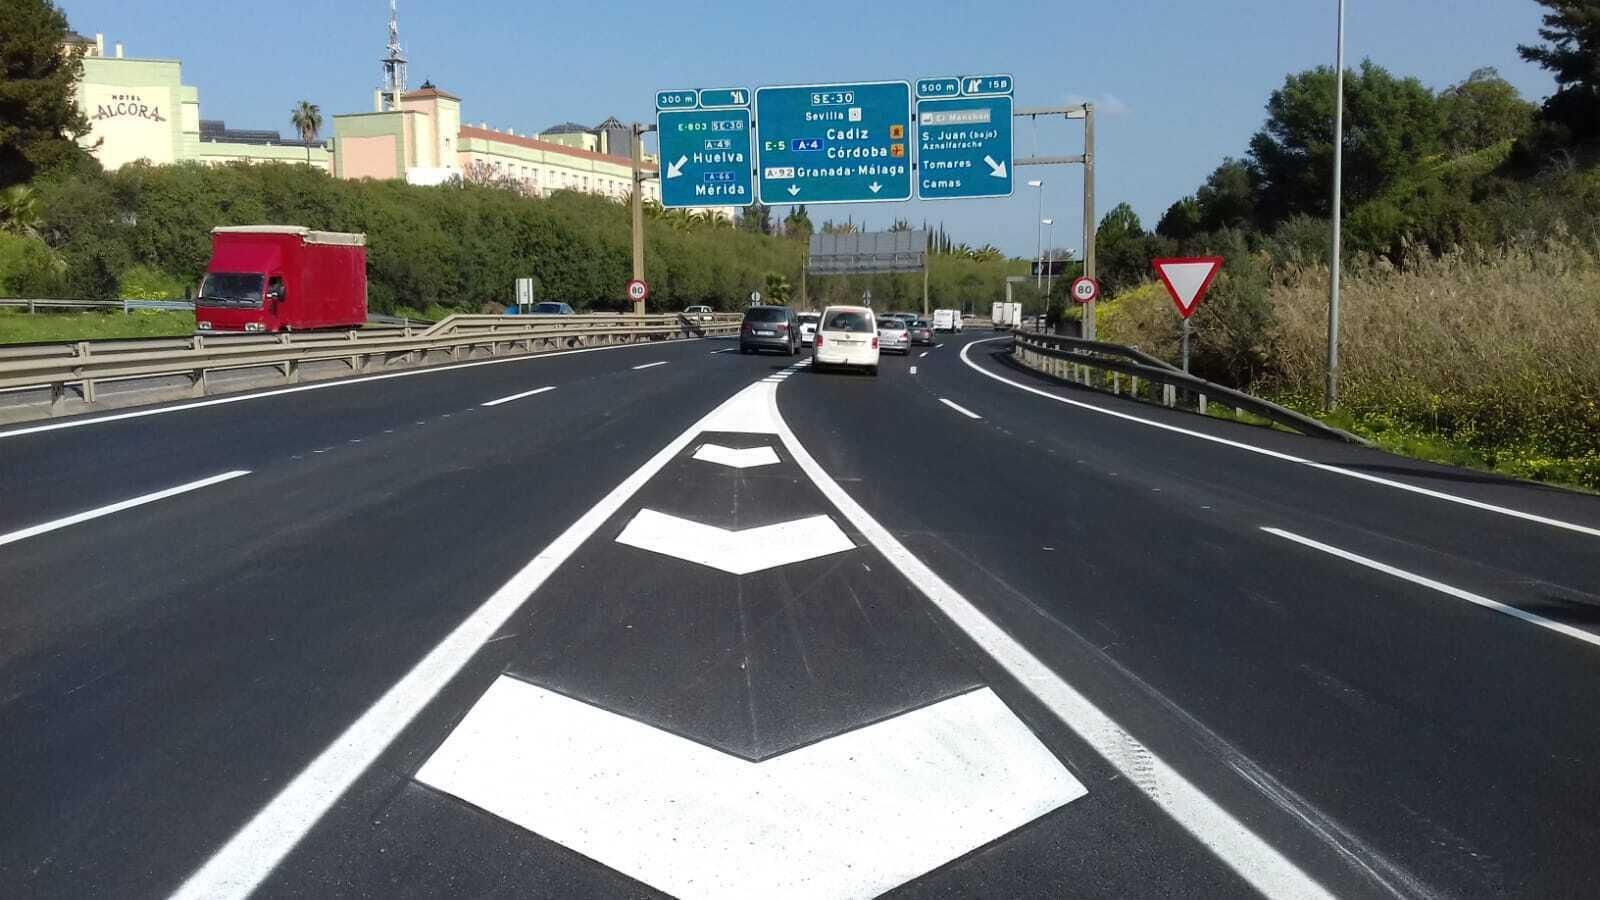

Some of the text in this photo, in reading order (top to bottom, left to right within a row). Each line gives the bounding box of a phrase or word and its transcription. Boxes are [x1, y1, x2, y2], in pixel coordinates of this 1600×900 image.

[921, 84, 941, 92] 500
[989, 81, 1007, 89] 15B
[662, 96, 681, 104] 300
[813, 94, 852, 104] SE-30
[91, 103, 167, 121] ALCORA
[806, 112, 844, 121] Sevilla
[678, 121, 743, 131] E-803 SE-30
[922, 132, 934, 141] S.
[938, 132, 966, 140] Juan
[765, 141, 785, 151] E-5
[798, 141, 818, 150] A-4
[923, 141, 982, 150] Aznalfarache
[827, 146, 887, 159] Córdoba
[693, 152, 744, 163] Huelva
[924, 160, 972, 169] Tomares
[767, 168, 793, 177] A-92
[923, 180, 961, 188] Camas
[696, 184, 744, 195] Mérida
[631, 286, 643, 295] 80
[1077, 285, 1092, 295] 80
